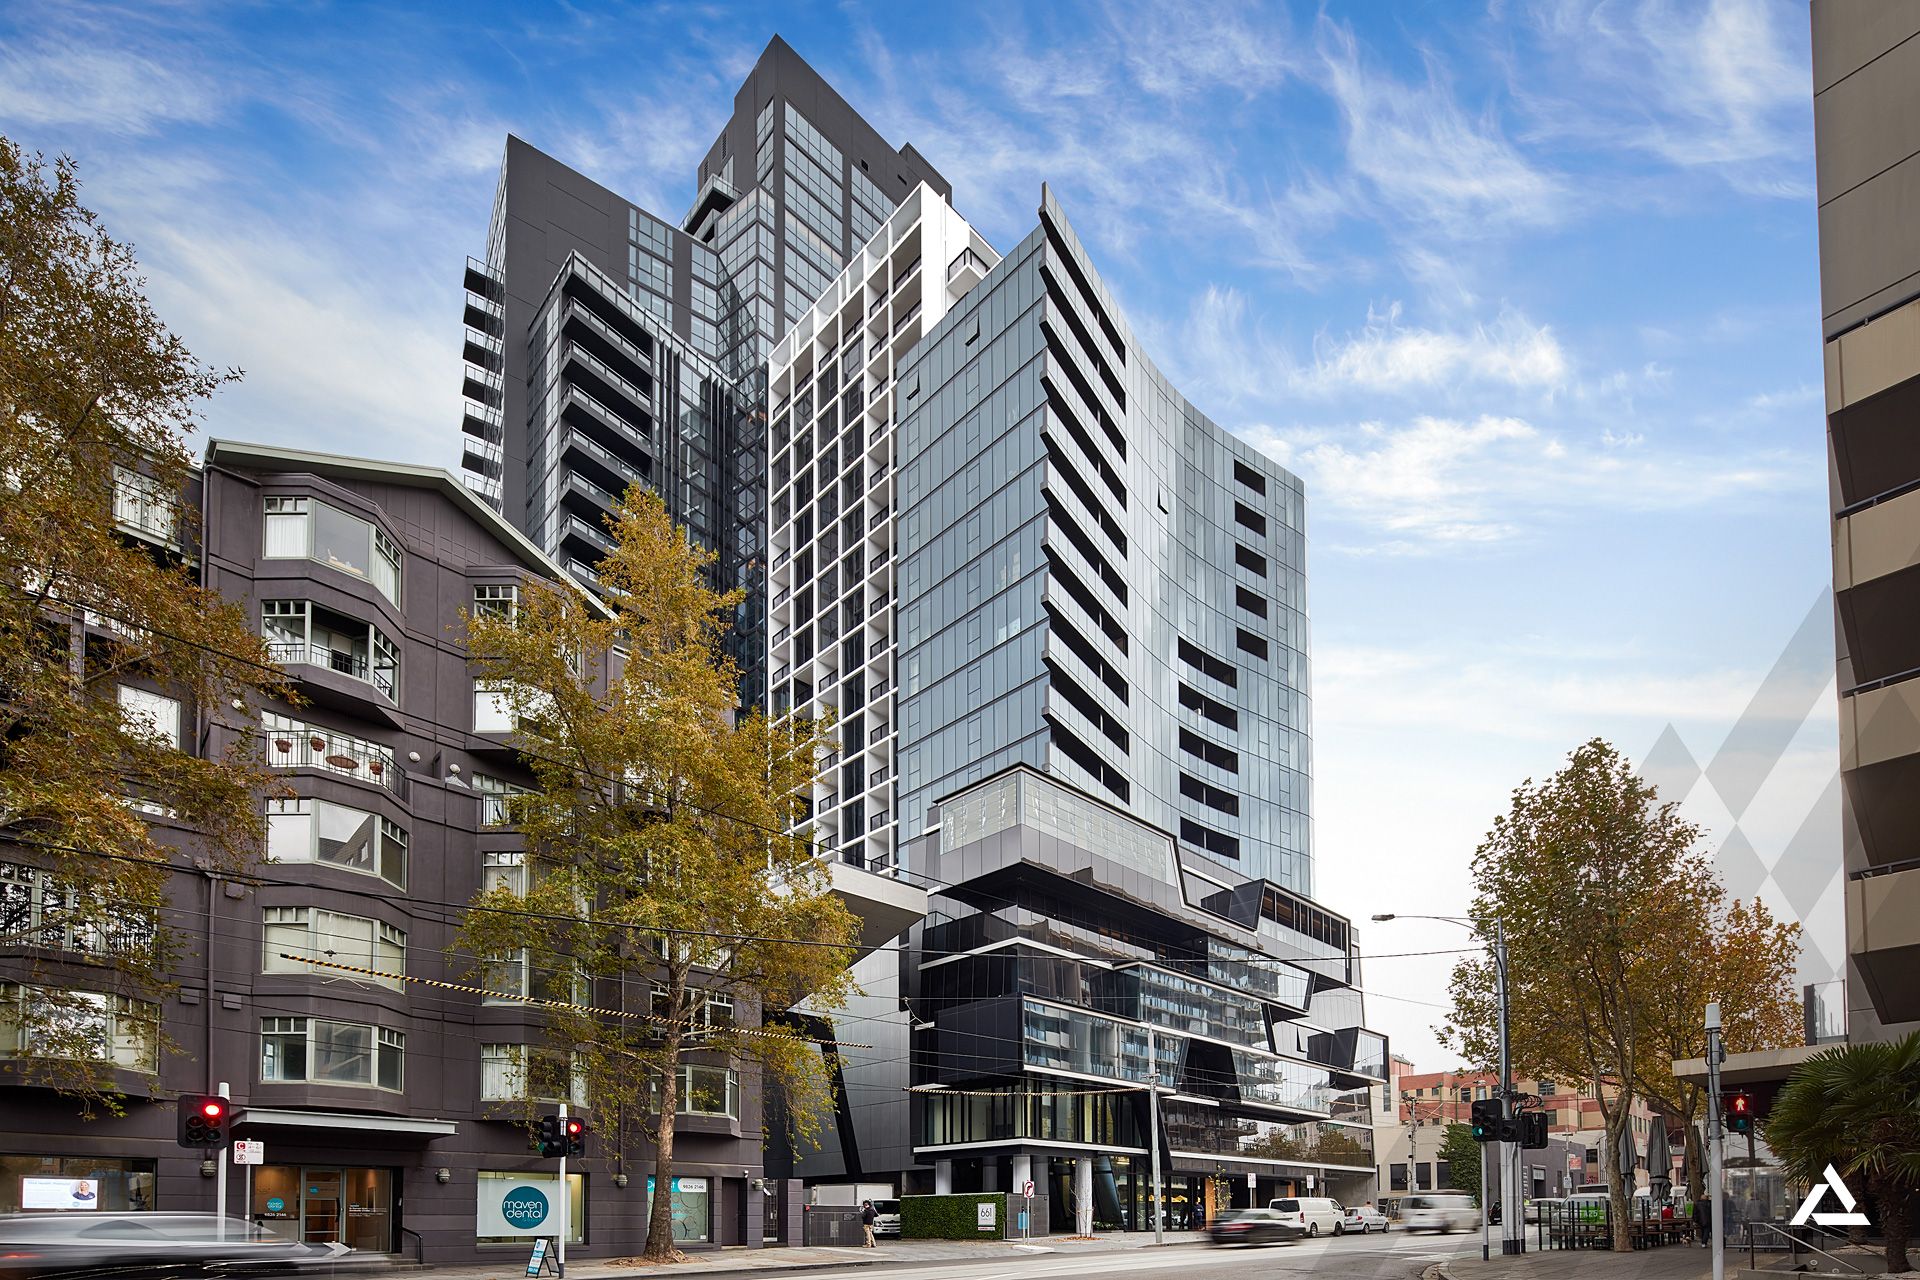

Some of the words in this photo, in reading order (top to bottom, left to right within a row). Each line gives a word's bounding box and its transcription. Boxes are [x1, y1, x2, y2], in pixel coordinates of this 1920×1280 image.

[504, 1200, 542, 1208] maven
[506, 1208, 542, 1218] dental
[980, 1208, 992, 1218] 661
